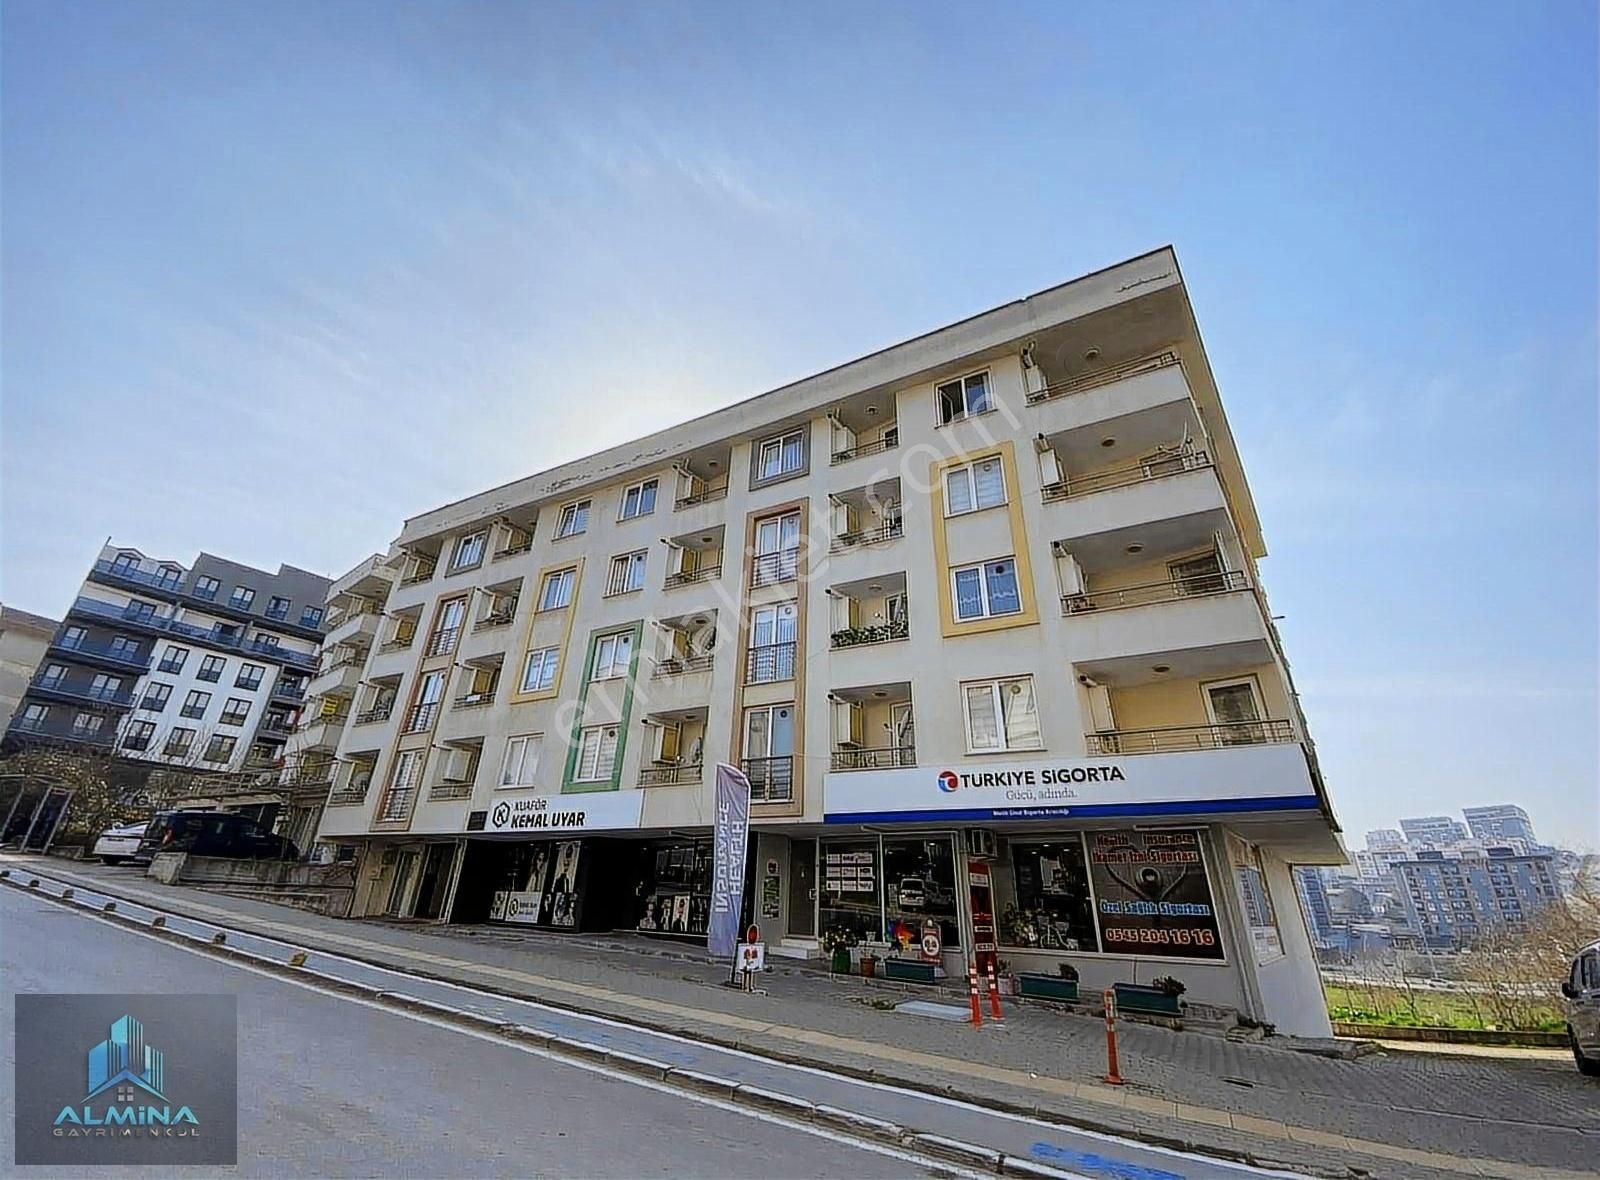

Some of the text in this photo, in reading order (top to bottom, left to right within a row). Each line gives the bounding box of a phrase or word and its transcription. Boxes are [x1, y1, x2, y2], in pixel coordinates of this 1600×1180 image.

[511, 811, 586, 829] KEMAL UYAR
[1105, 927, 1215, 946] 0545 204 16 16
